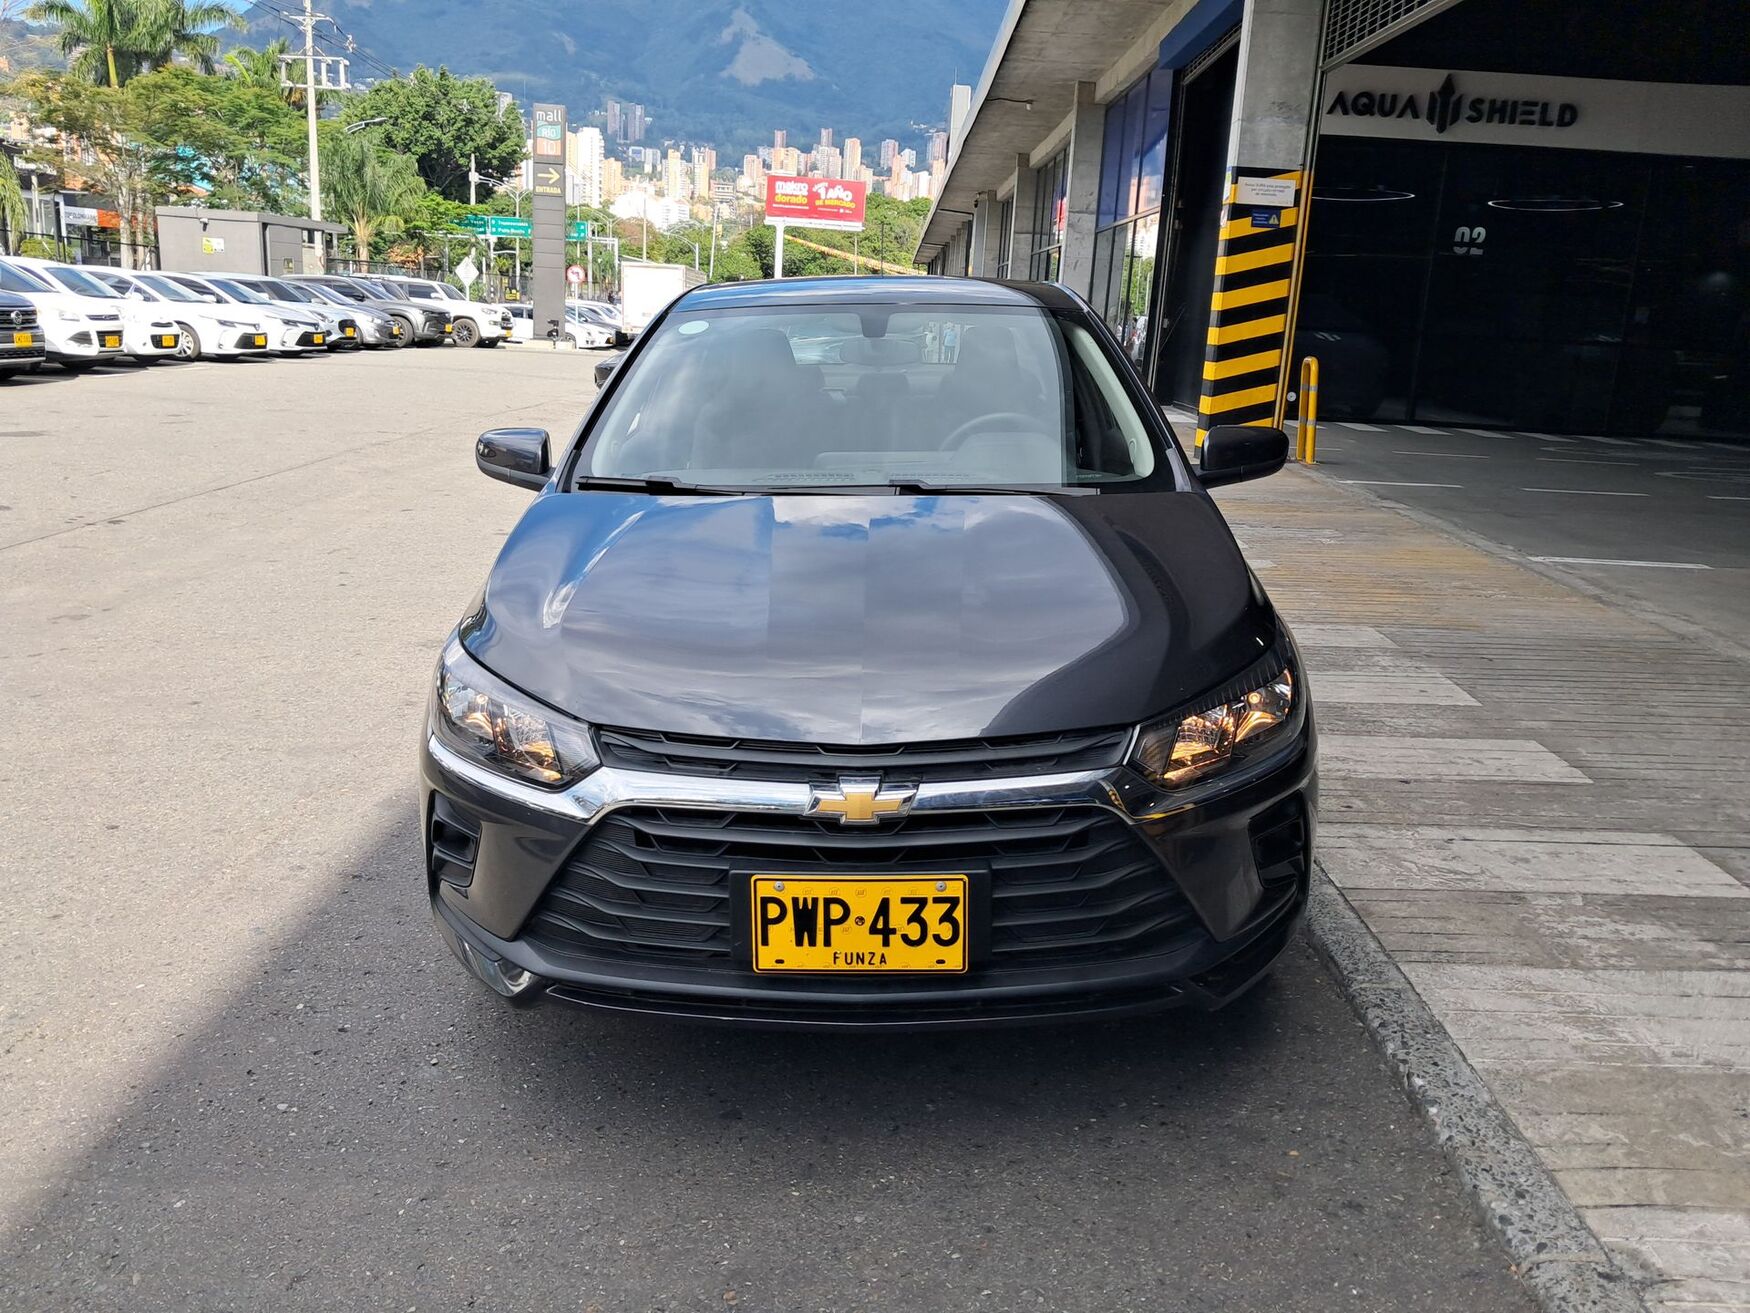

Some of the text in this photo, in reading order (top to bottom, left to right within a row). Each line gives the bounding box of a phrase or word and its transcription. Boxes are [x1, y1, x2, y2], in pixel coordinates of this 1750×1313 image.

[536, 110, 562, 122] mall
[1326, 91, 1578, 128] AQUA SHIELD
[775, 194, 807, 204] dorado
[1453, 226, 1486, 255] 02
[833, 951, 888, 966] FUNZA
